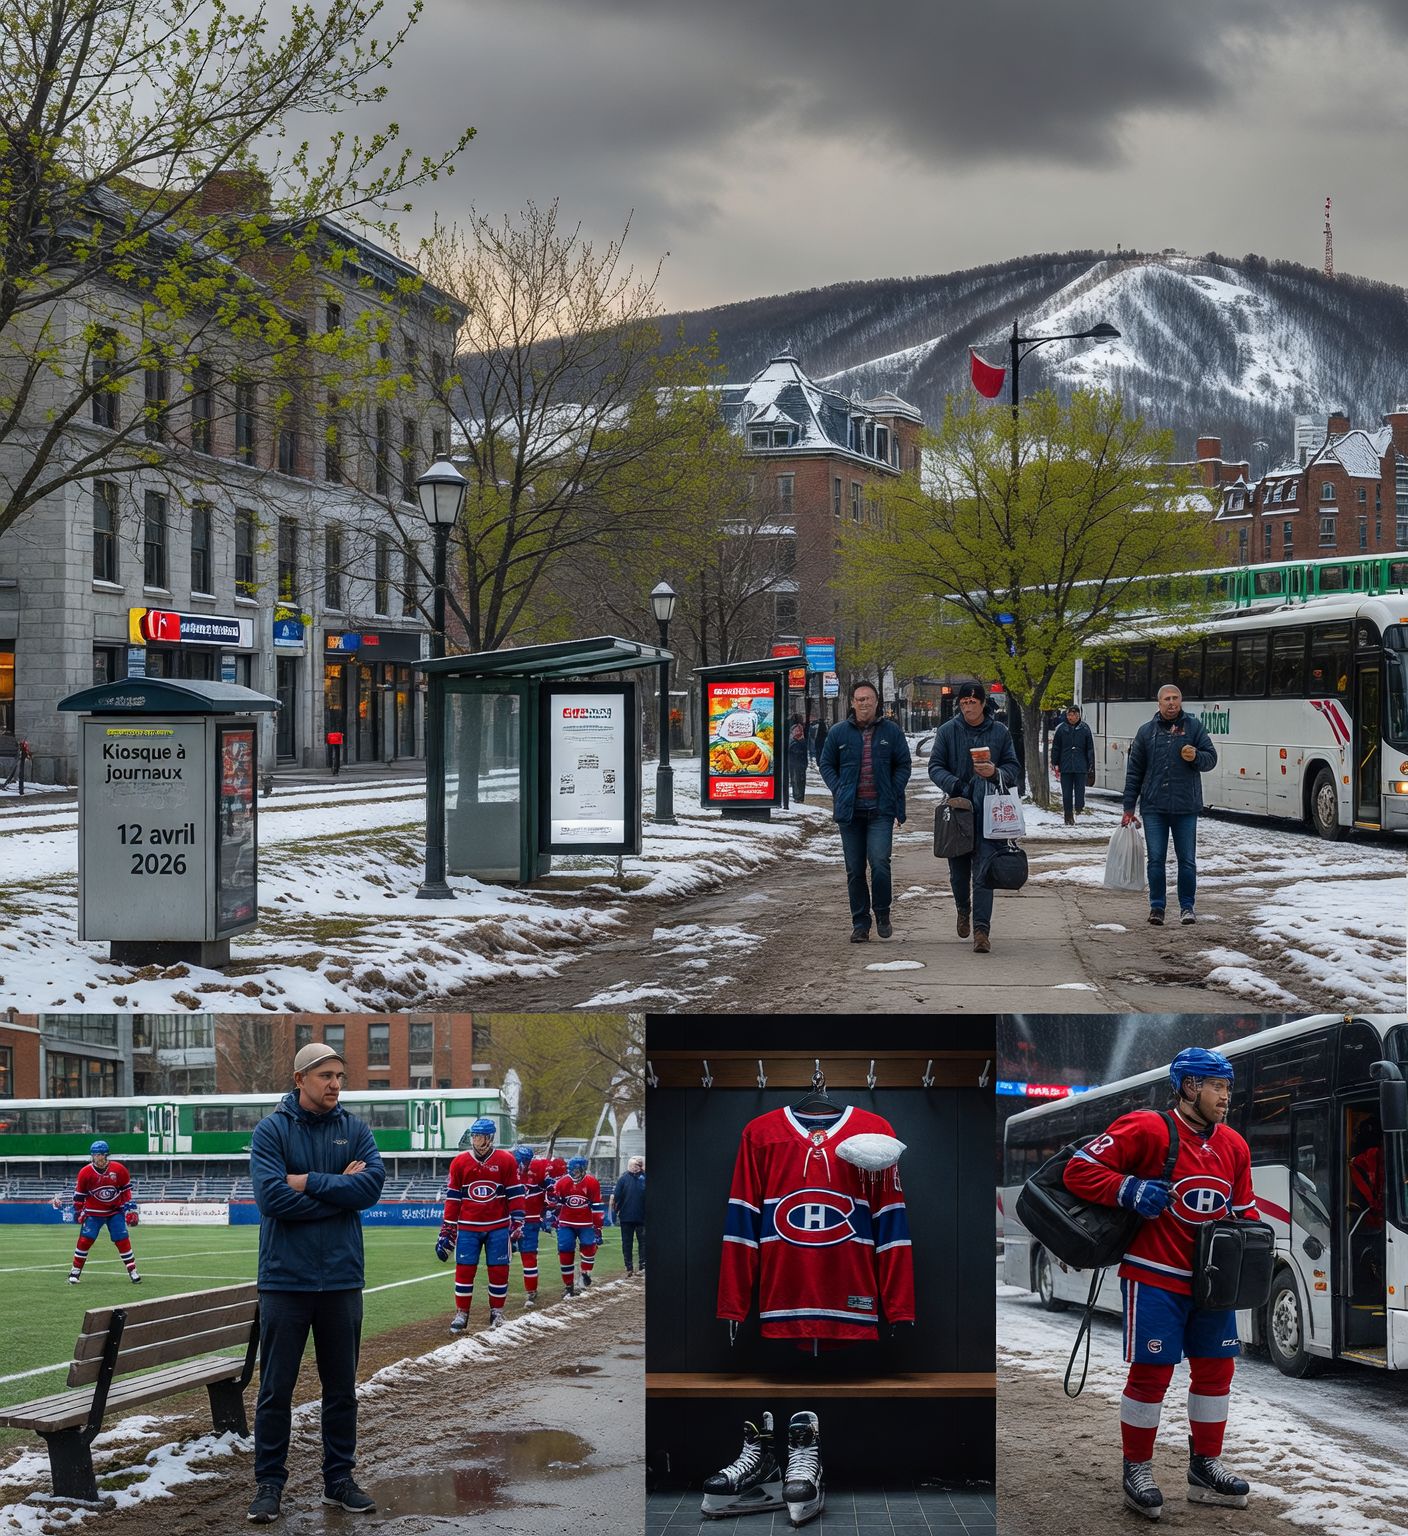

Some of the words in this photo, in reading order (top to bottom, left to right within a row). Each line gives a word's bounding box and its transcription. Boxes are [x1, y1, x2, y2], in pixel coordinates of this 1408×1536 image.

[103, 744, 172, 763] Kiosque
[177, 744, 185, 759] à
[105, 764, 182, 783] journaux
[117, 824, 142, 844] 12
[150, 823, 195, 844] avril
[130, 854, 186, 874] 2026
